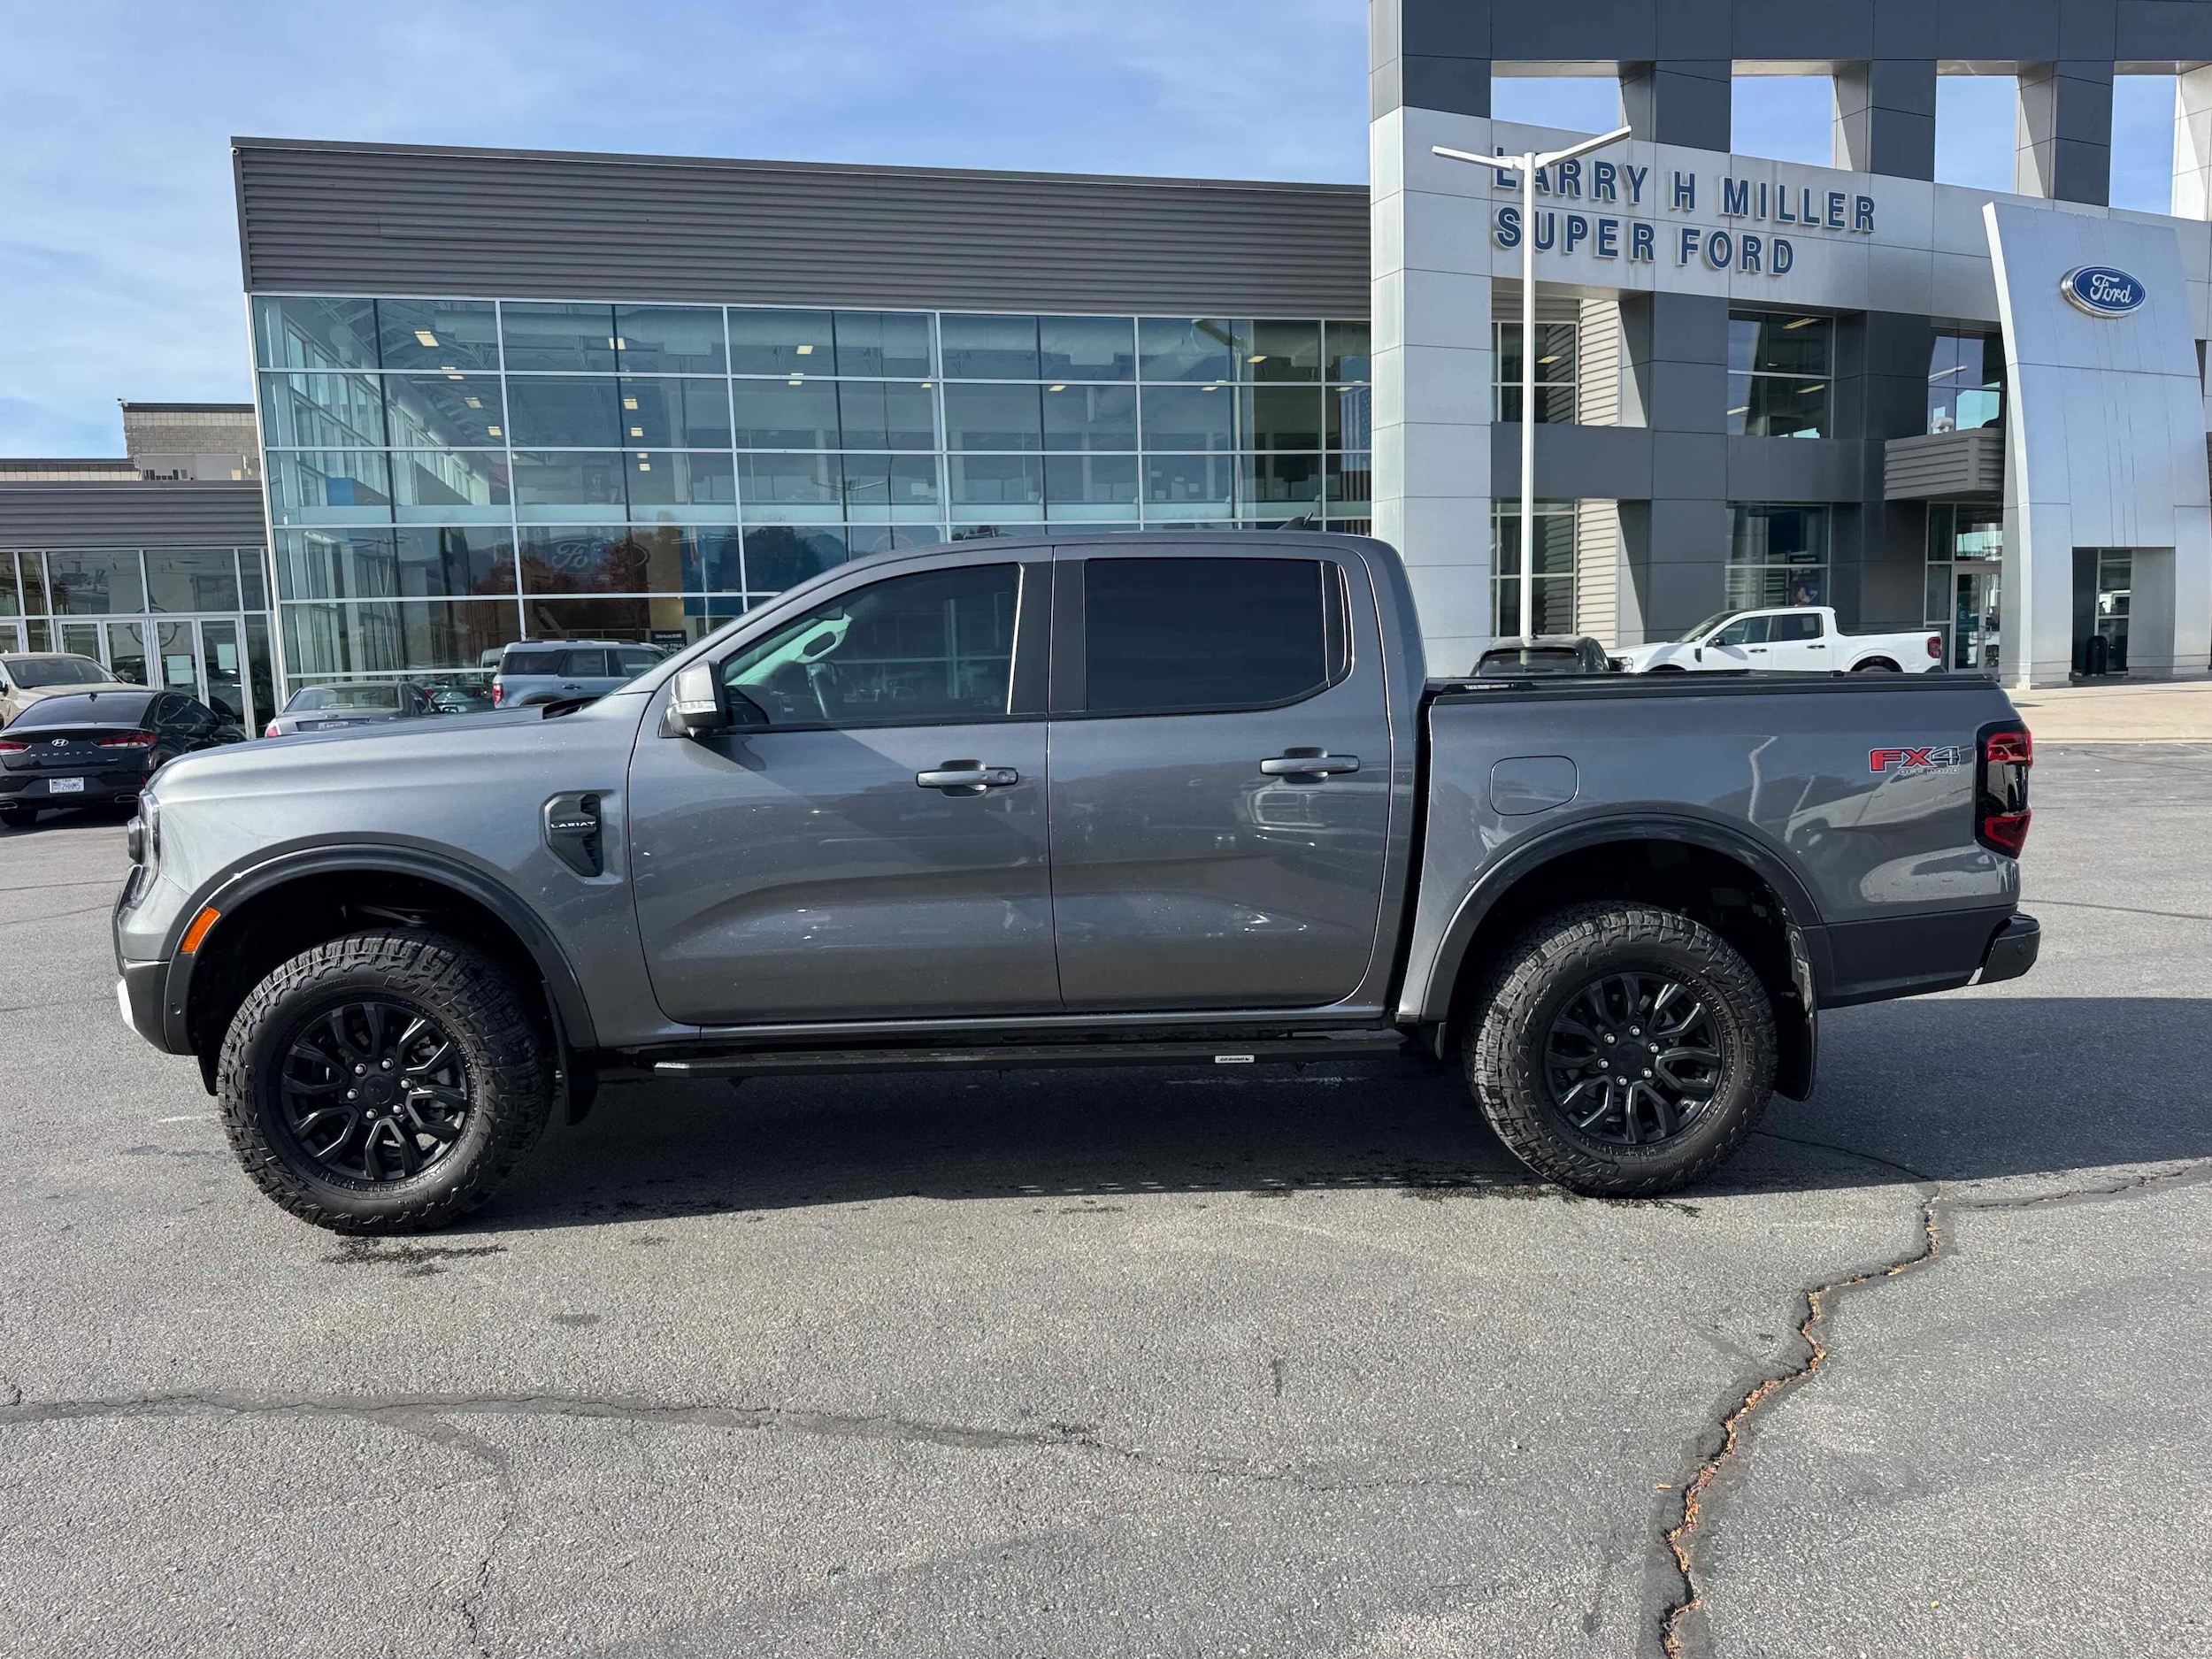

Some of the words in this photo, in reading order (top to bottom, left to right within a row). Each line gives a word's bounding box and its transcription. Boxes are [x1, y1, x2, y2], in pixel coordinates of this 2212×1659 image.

[1670, 170, 1696, 211] H
[1720, 177, 1876, 233] MILLER
[1495, 206, 1655, 262] SUPER
[1678, 227, 1794, 276] FORD
[2090, 273, 2132, 303] Ford
[1869, 746, 1961, 773] FX4
